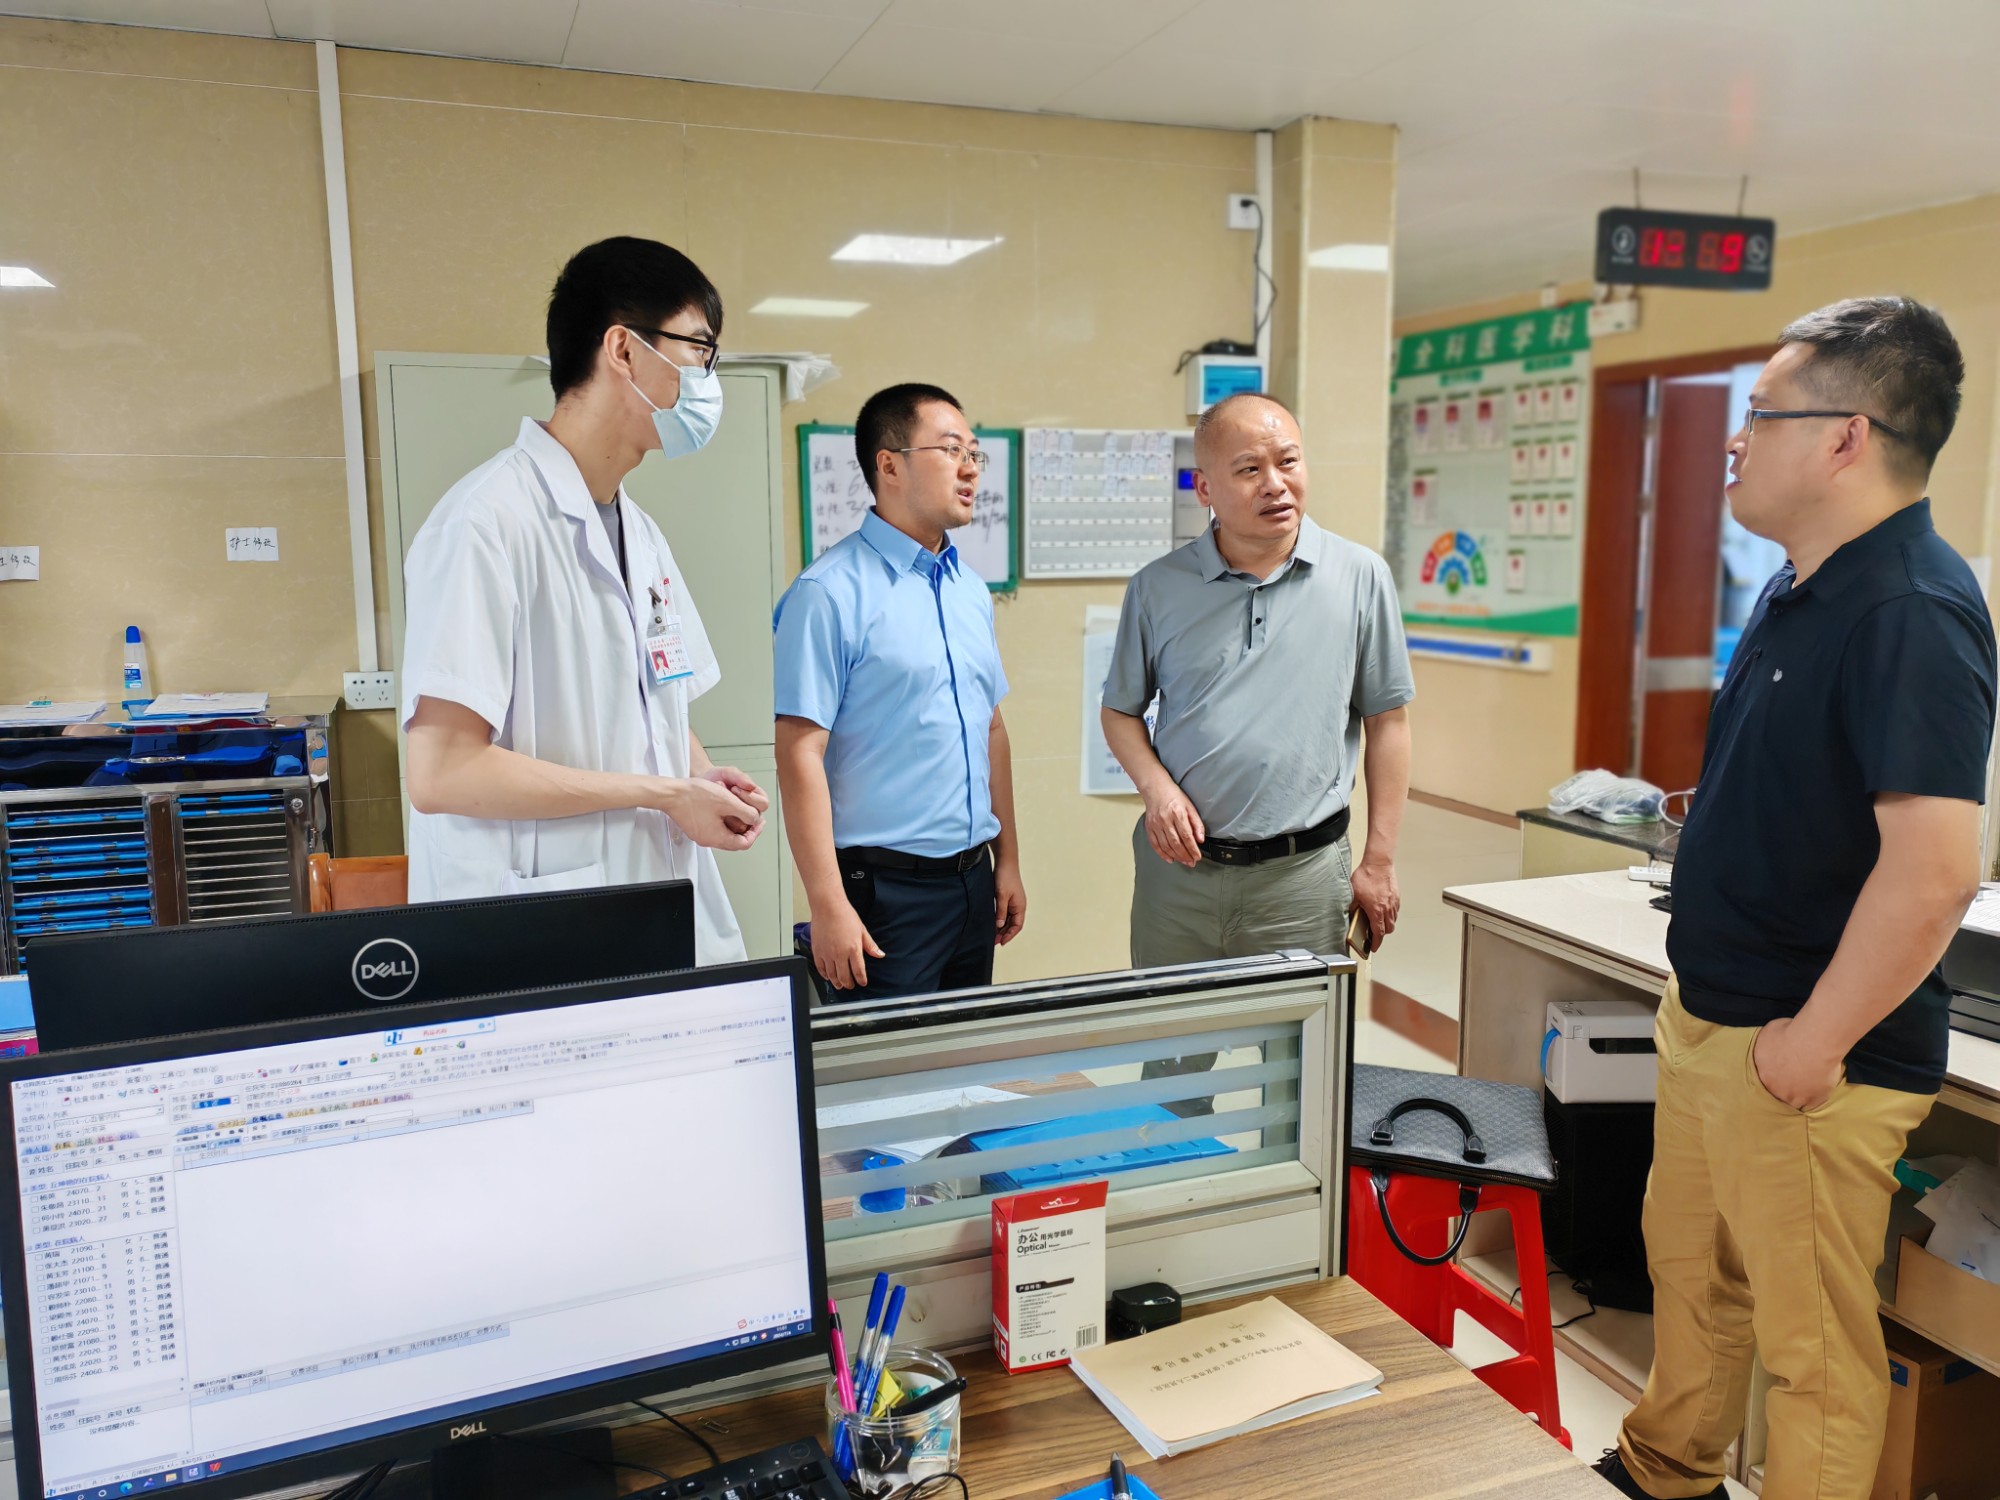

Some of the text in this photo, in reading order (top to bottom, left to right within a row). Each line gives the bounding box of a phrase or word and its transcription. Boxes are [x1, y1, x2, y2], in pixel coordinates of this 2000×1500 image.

[1413, 311, 1576, 370] 全科医学科
[361, 960, 413, 980] DELL
[21, 1109, 68, 1123] 住院病人列表
[56, 1129, 72, 1139] 姓名
[54, 1141, 71, 1150] 在院
[76, 1137, 93, 1147] 出院
[37, 1165, 54, 1175] 姓名
[64, 1159, 88, 1170] 住院号
[148, 1174, 164, 1184] 普通
[149, 1184, 164, 1194] 普通
[149, 1194, 165, 1204] 普通
[150, 1204, 166, 1214] 普通
[152, 1230, 168, 1240] 普通
[1018, 1232, 1039, 1245] 办公
[1040, 1228, 1074, 1241] 用光学鼠标
[153, 1241, 168, 1251] 普通
[1016, 1242, 1047, 1254] Optical
[153, 1251, 169, 1260] 普通
[154, 1261, 170, 1271] 普通
[155, 1271, 171, 1281] 普通
[155, 1281, 171, 1291] 普通
[156, 1291, 172, 1301] 普通
[157, 1301, 173, 1311] 普通
[158, 1311, 173, 1321] 普通
[158, 1321, 174, 1332] 普通
[159, 1332, 175, 1342] 普通
[160, 1342, 175, 1352] 普通
[160, 1352, 176, 1362] 普通
[49, 1421, 66, 1432] 姓名
[77, 1413, 102, 1426] 住院号
[125, 1405, 142, 1415] 状态
[450, 1421, 487, 1440] DELL
